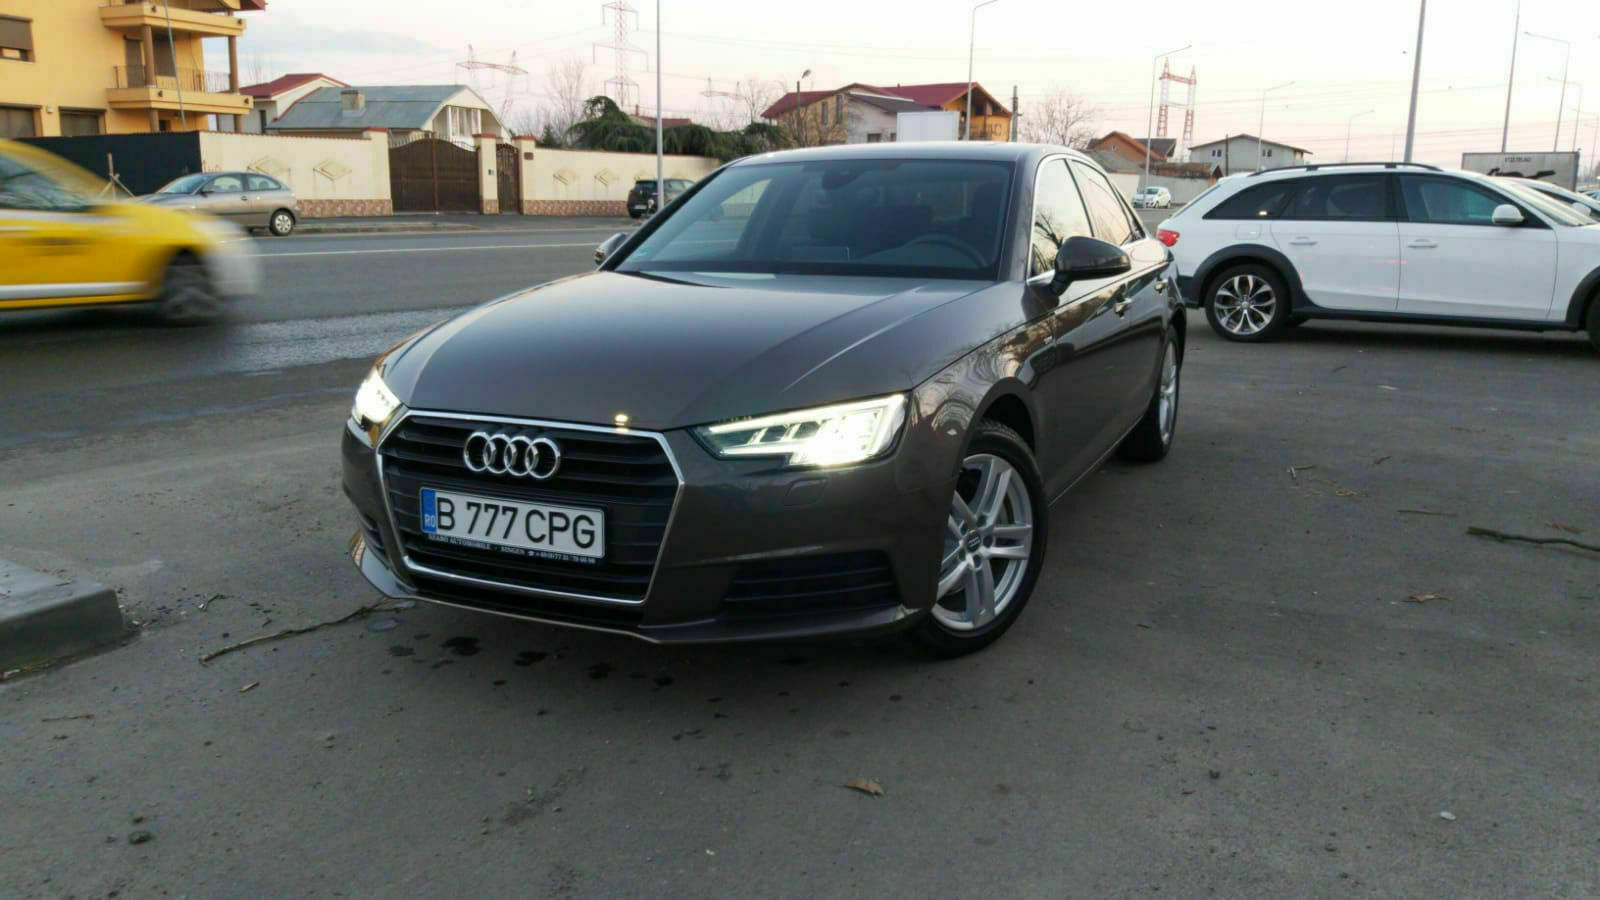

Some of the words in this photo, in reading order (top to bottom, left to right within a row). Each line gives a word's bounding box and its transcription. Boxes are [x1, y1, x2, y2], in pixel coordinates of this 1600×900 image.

[424, 513, 436, 528] RO
[437, 497, 455, 531] B
[466, 501, 518, 540] 777
[525, 509, 595, 549] CPG
